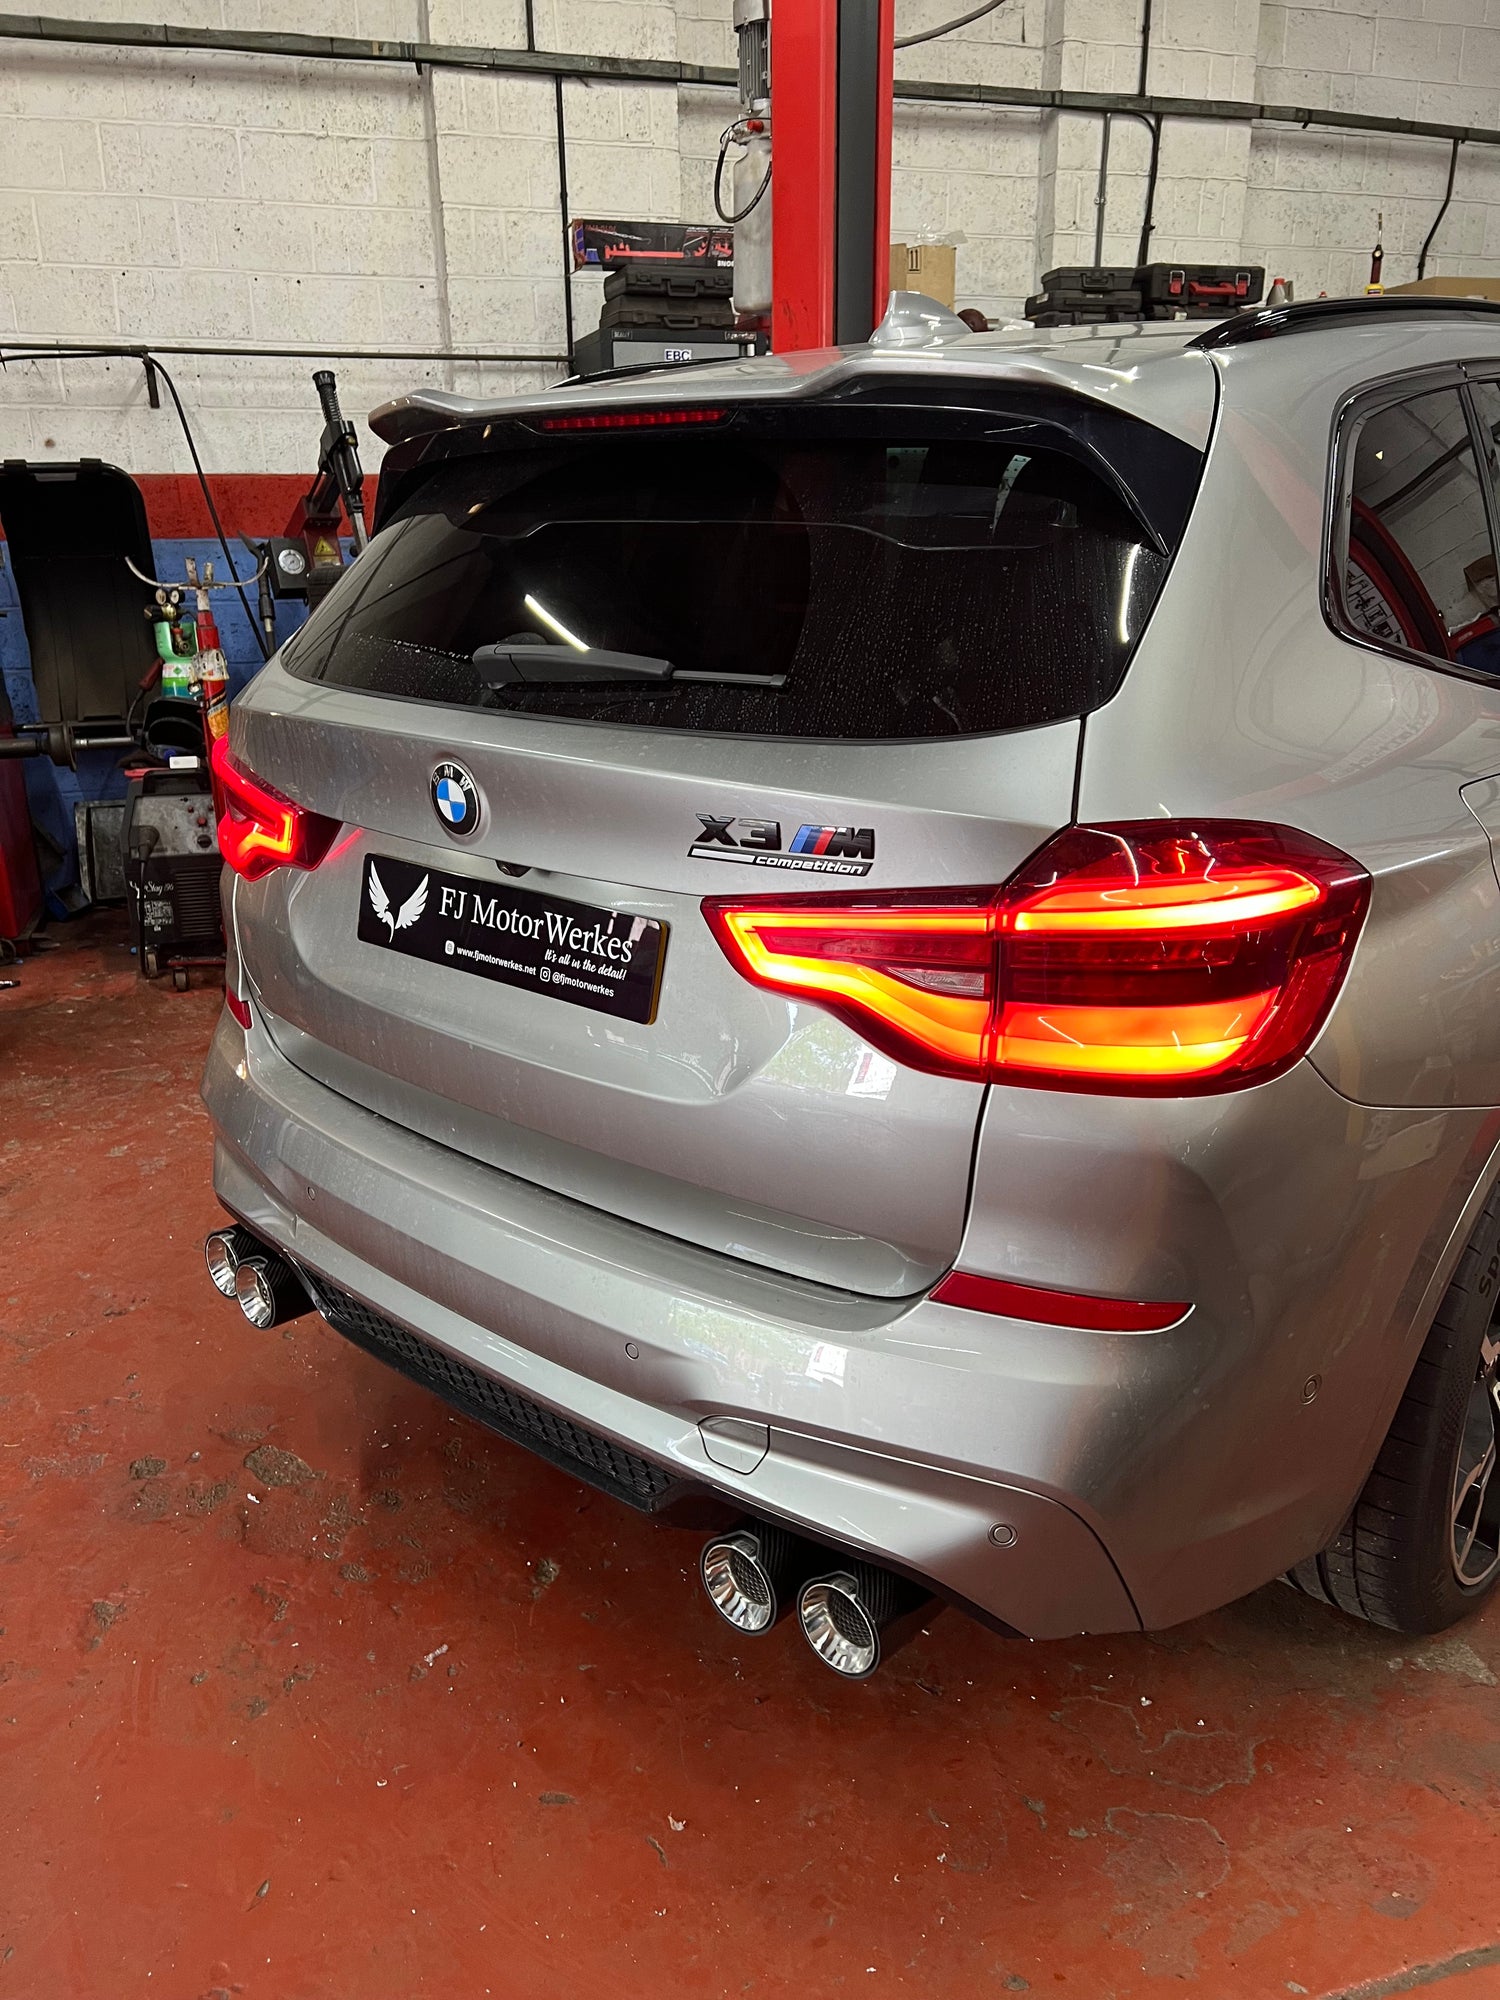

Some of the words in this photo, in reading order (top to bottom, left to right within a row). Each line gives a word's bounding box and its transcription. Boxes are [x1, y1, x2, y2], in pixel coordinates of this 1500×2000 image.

[665, 350, 690, 361] EBC
[432, 765, 472, 792] BMW
[694, 813, 782, 851] X3
[755, 855, 865, 876] competition
[438, 886, 468, 920] FJ
[470, 893, 633, 963] MotorWerkes
[456, 946, 537, 976] www.fjmotorwerkes.net
[544, 948, 558, 963] It's
[558, 953, 571, 966] all
[571, 959, 581, 969] in
[582, 958, 596, 973] the
[597, 963, 627, 981] detail!
[552, 971, 615, 997] @fjmotorwerkes
